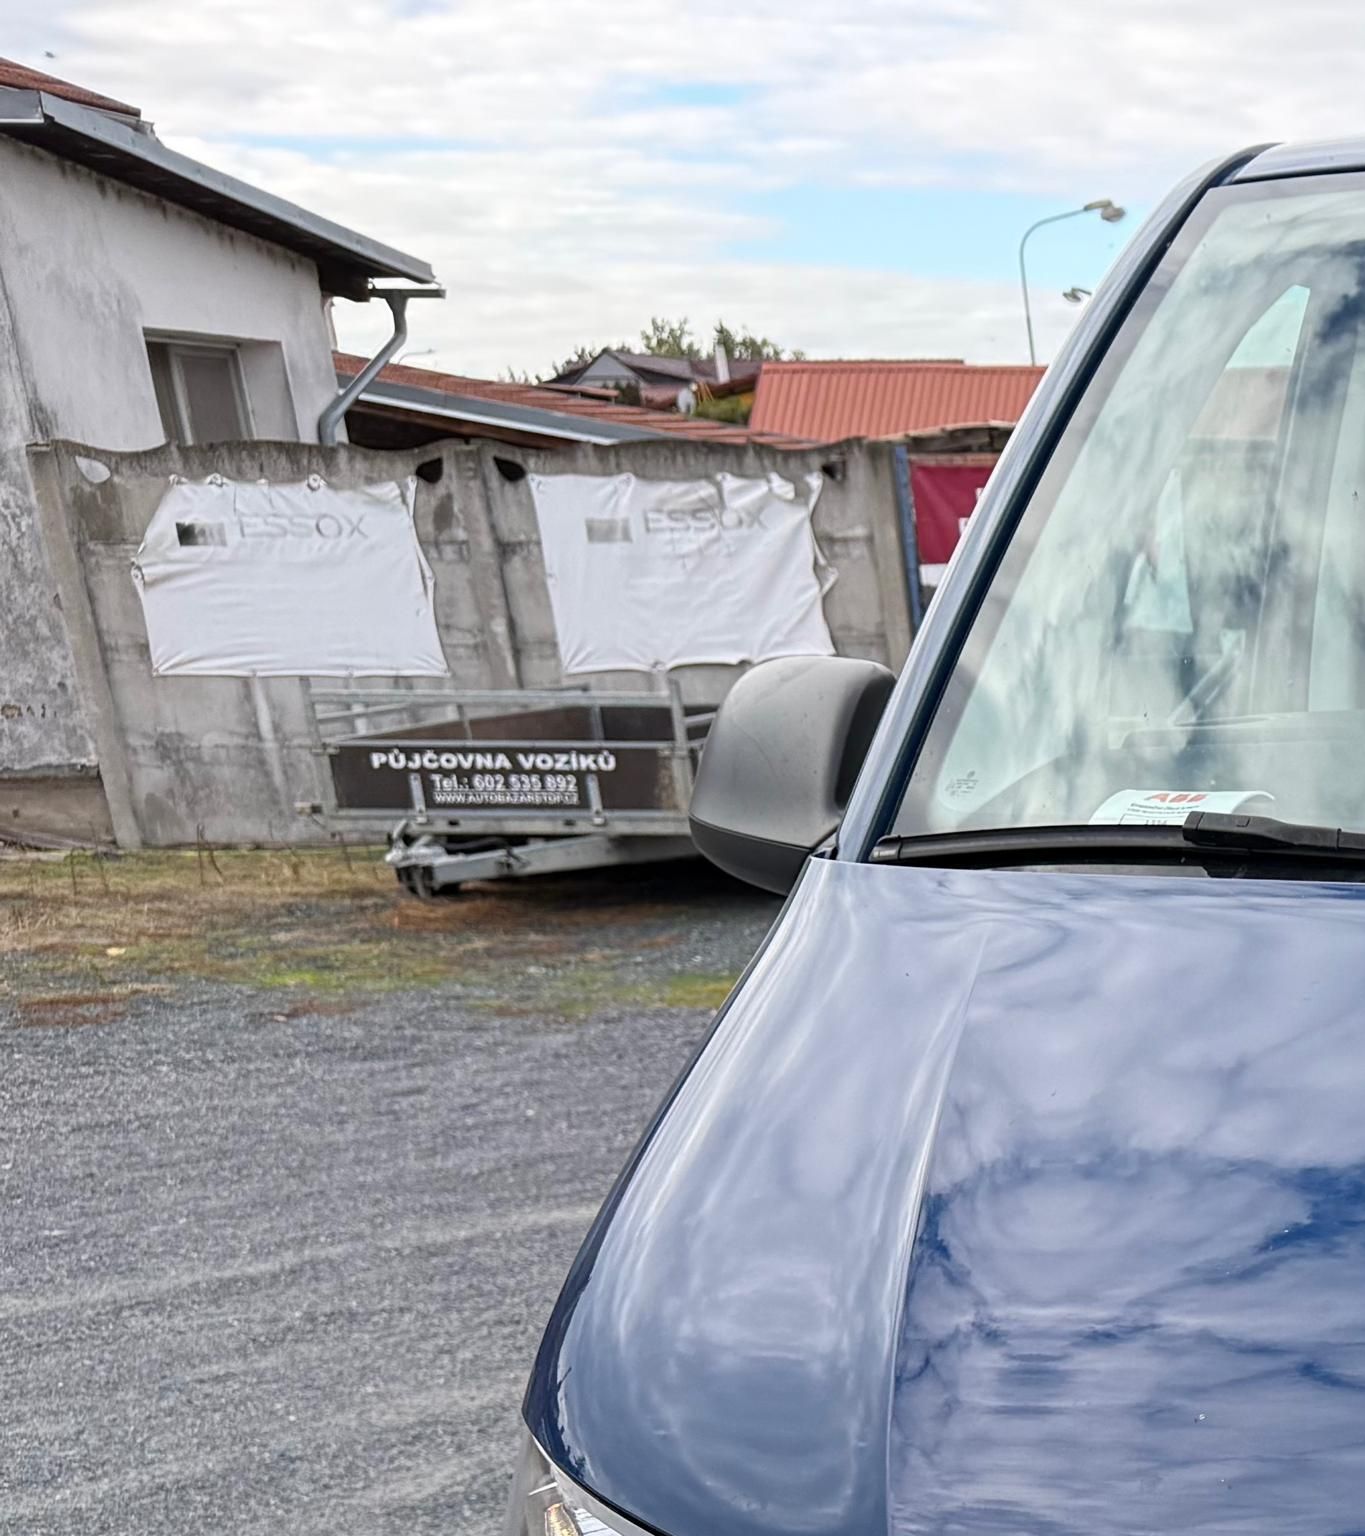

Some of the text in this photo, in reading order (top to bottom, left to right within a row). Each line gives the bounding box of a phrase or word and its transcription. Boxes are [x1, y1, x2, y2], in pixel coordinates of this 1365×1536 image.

[238, 511, 369, 540] ESSOX
[643, 506, 771, 534] ESSOX
[371, 749, 617, 771] PŮJČOVNA VOZÍKŮ
[430, 774, 578, 792] Tel.: 602 535 892
